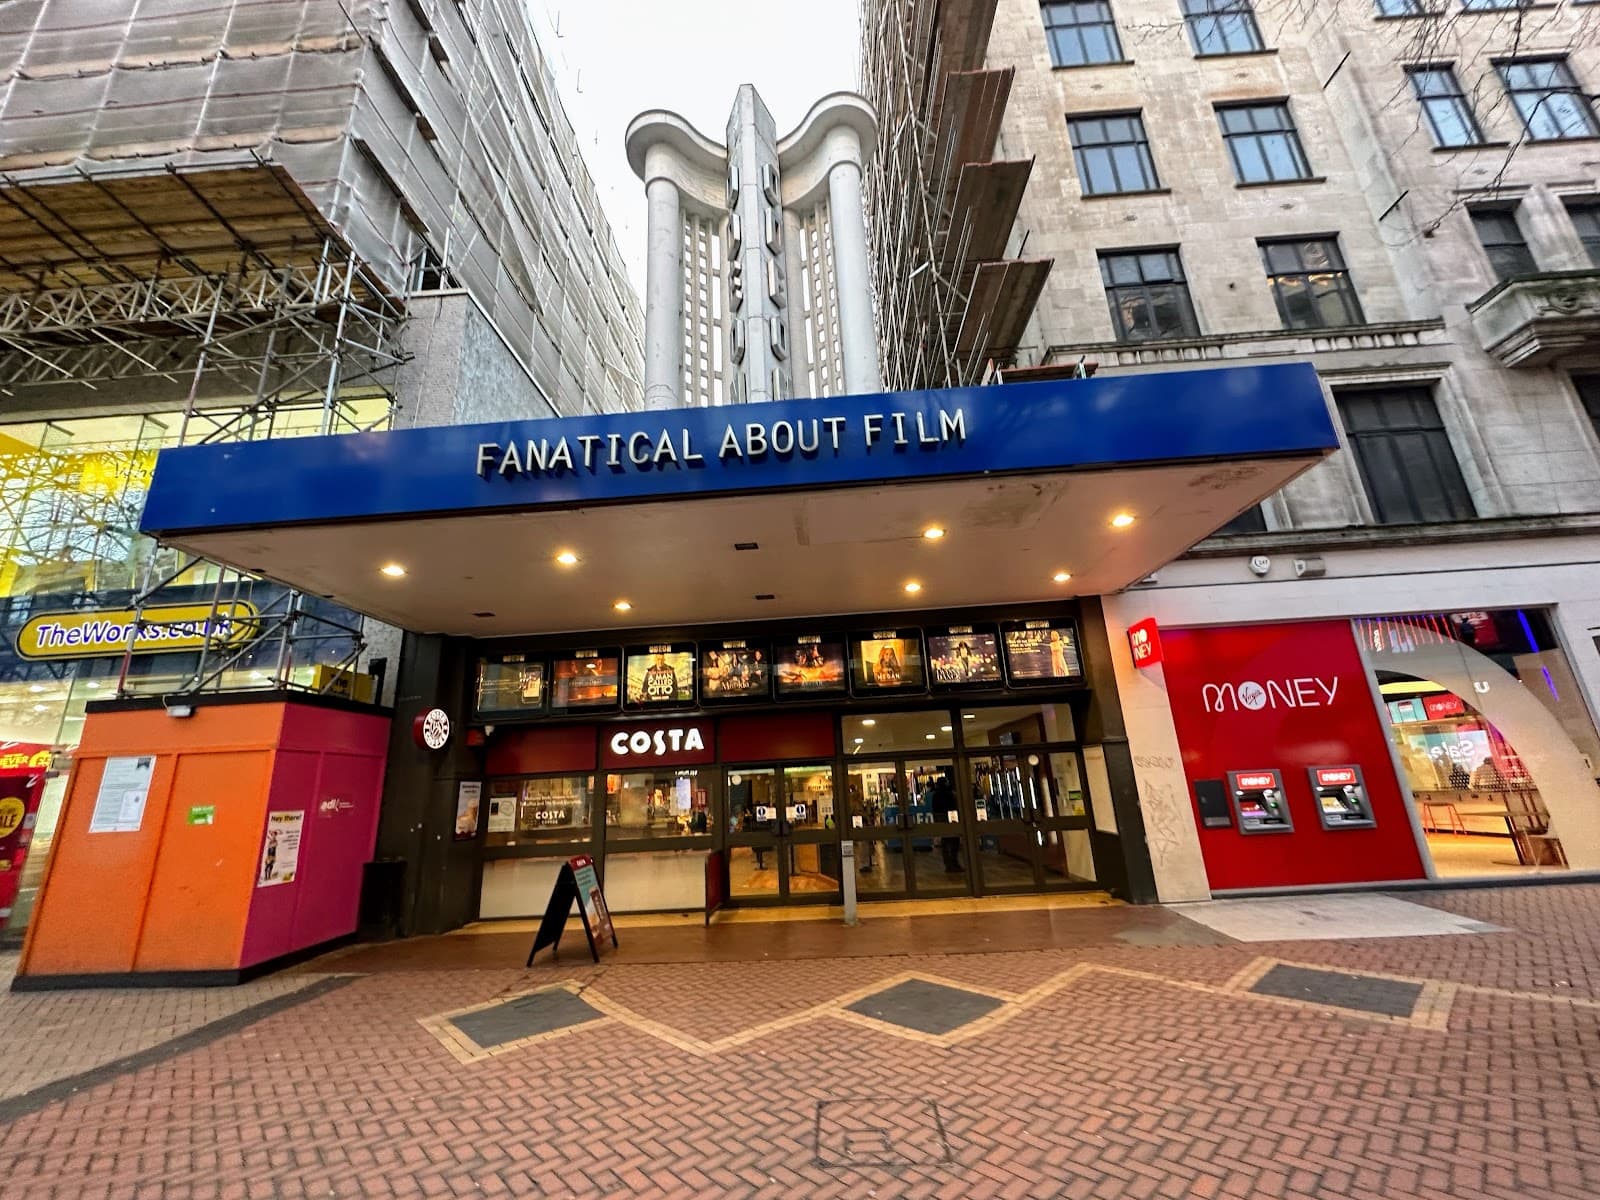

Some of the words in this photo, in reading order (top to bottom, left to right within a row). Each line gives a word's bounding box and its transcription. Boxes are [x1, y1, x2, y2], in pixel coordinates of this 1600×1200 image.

[476, 428, 703, 476] FANATICAL
[718, 416, 846, 458] ABOUT
[864, 408, 967, 447] FILM
[610, 728, 705, 756] COSTA
[535, 810, 565, 820] COSTA
